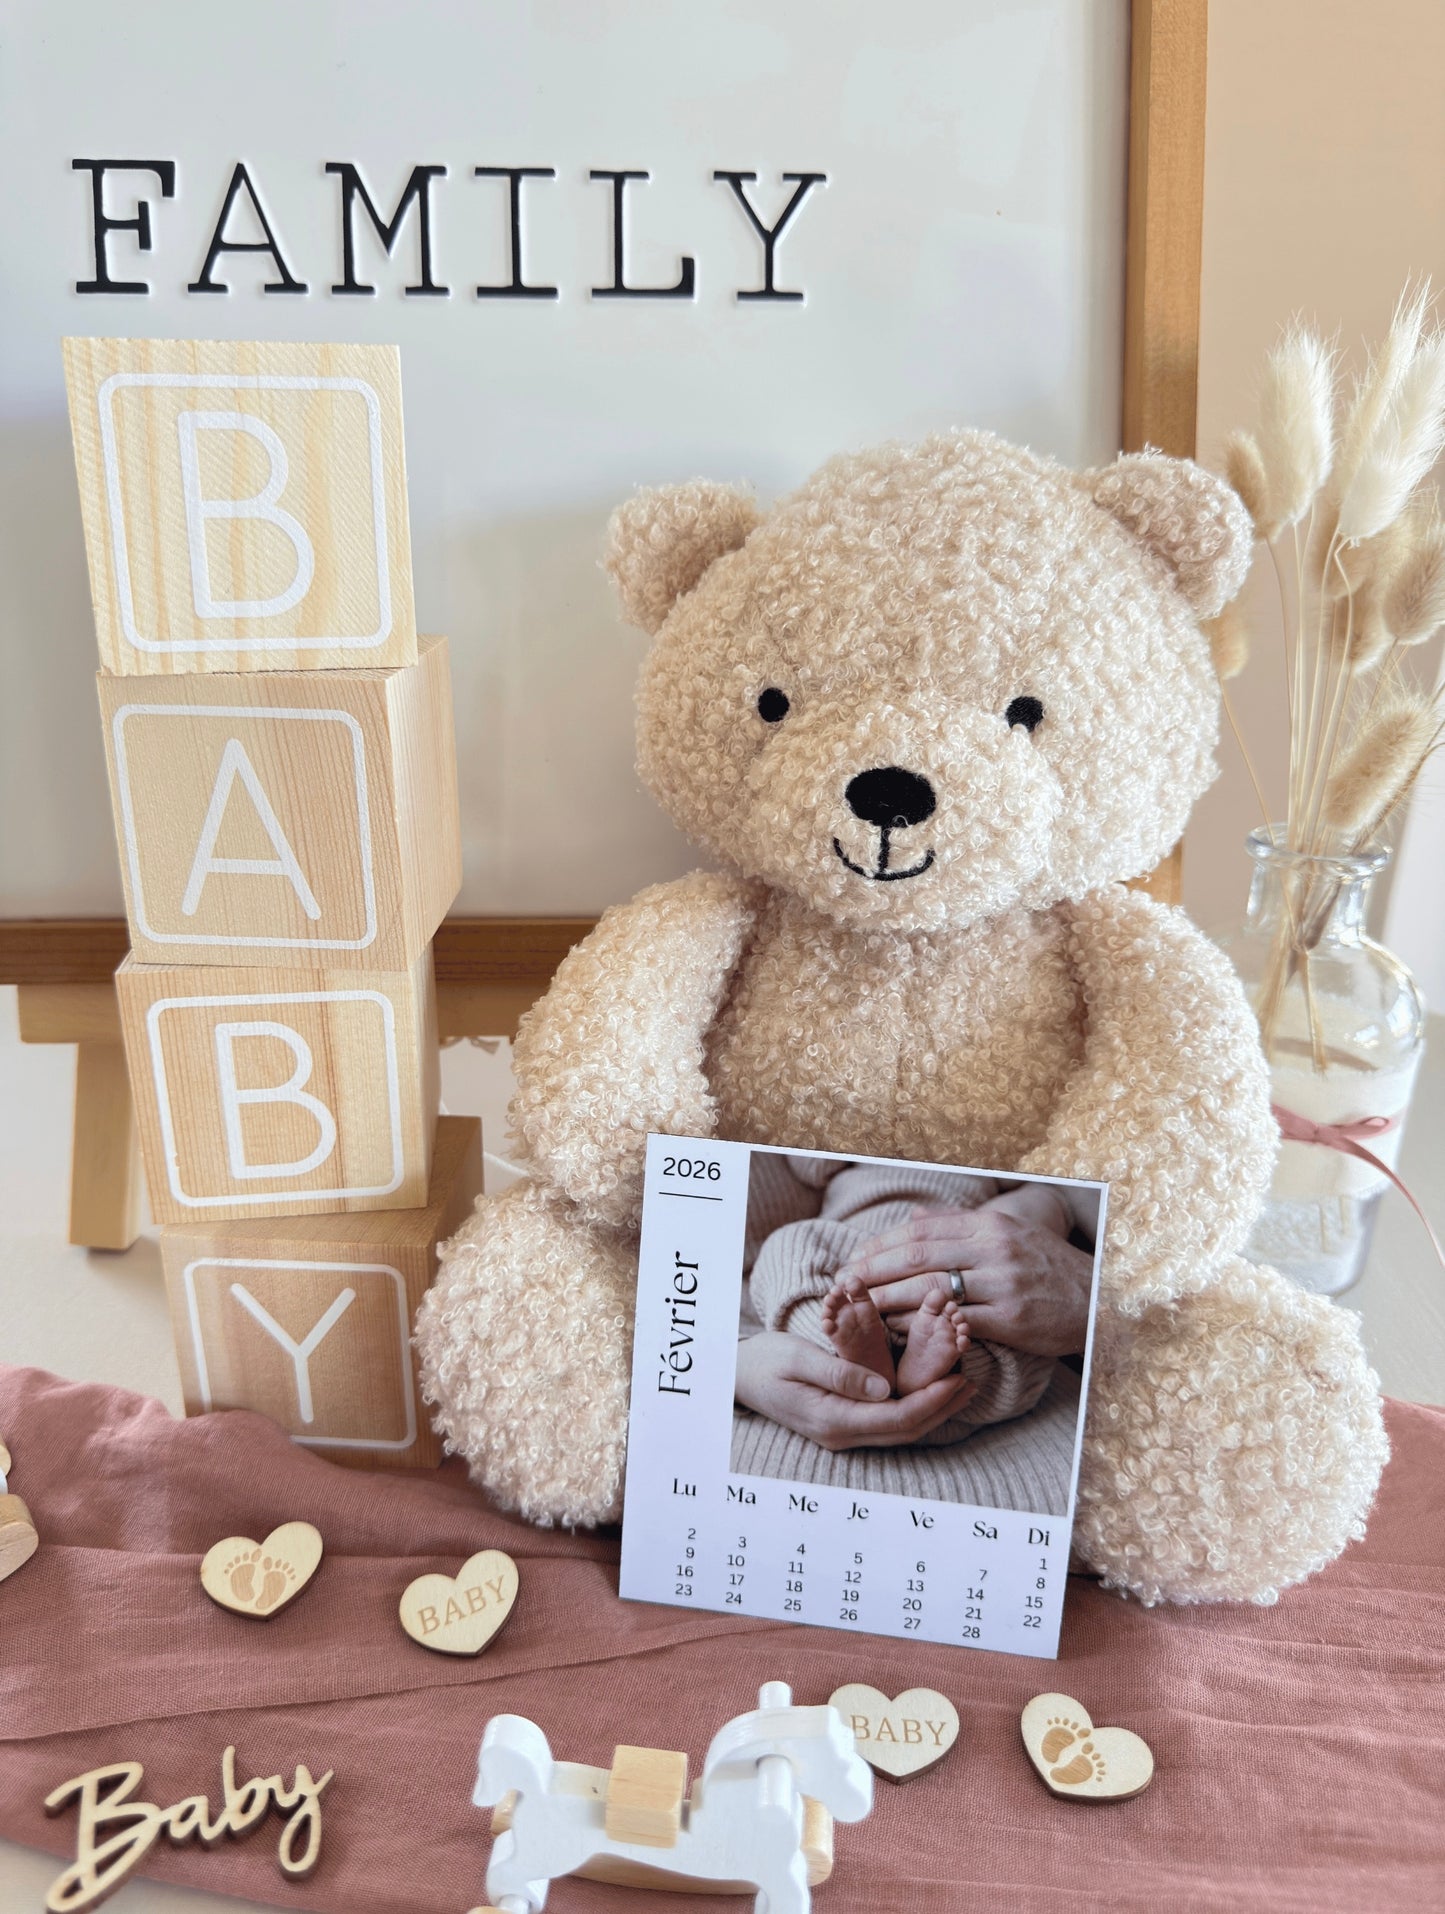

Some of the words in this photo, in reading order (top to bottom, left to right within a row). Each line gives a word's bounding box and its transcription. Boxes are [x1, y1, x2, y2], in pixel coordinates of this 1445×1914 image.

[72, 157, 828, 303] FAMILY
[662, 1156, 722, 1182] 2026
[657, 1250, 700, 1397] Février
[671, 1477, 697, 1498] Lu
[725, 1484, 757, 1506] Ma
[787, 1493, 819, 1514] Me
[846, 1501, 870, 1521] Je
[909, 1510, 935, 1530] Ve
[972, 1520, 999, 1541] Sa
[1027, 1527, 1051, 1547] Di
[685, 1546, 695, 1560] 9
[727, 1554, 746, 1568] 10
[787, 1561, 805, 1575] 11
[844, 1570, 862, 1584] 12
[906, 1578, 925, 1593] 13
[965, 1587, 985, 1601] 14
[1024, 1595, 1044, 1609] 15
[687, 1527, 697, 1541] 2
[737, 1536, 747, 1550] 3
[796, 1543, 806, 1556] 4
[853, 1552, 863, 1566] 5
[915, 1560, 926, 1574] 6
[978, 1569, 988, 1582] 7
[1035, 1576, 1046, 1590] 8
[1039, 1558, 1048, 1571] 1
[416, 1574, 506, 1636] BABY
[674, 1582, 693, 1597] 23
[724, 1591, 743, 1606] 24
[783, 1598, 802, 1612] 25
[839, 1607, 858, 1622] 26
[902, 1616, 922, 1630] 27
[961, 1625, 981, 1640] 28
[675, 1564, 694, 1578] 16
[729, 1573, 745, 1586] 17
[785, 1579, 803, 1593] 18
[841, 1588, 860, 1603] 19
[902, 1597, 923, 1612] 20
[964, 1606, 983, 1621] 21
[1022, 1614, 1042, 1629] 22
[849, 1714, 947, 1746] BABY
[43, 1745, 335, 1914] Baby
